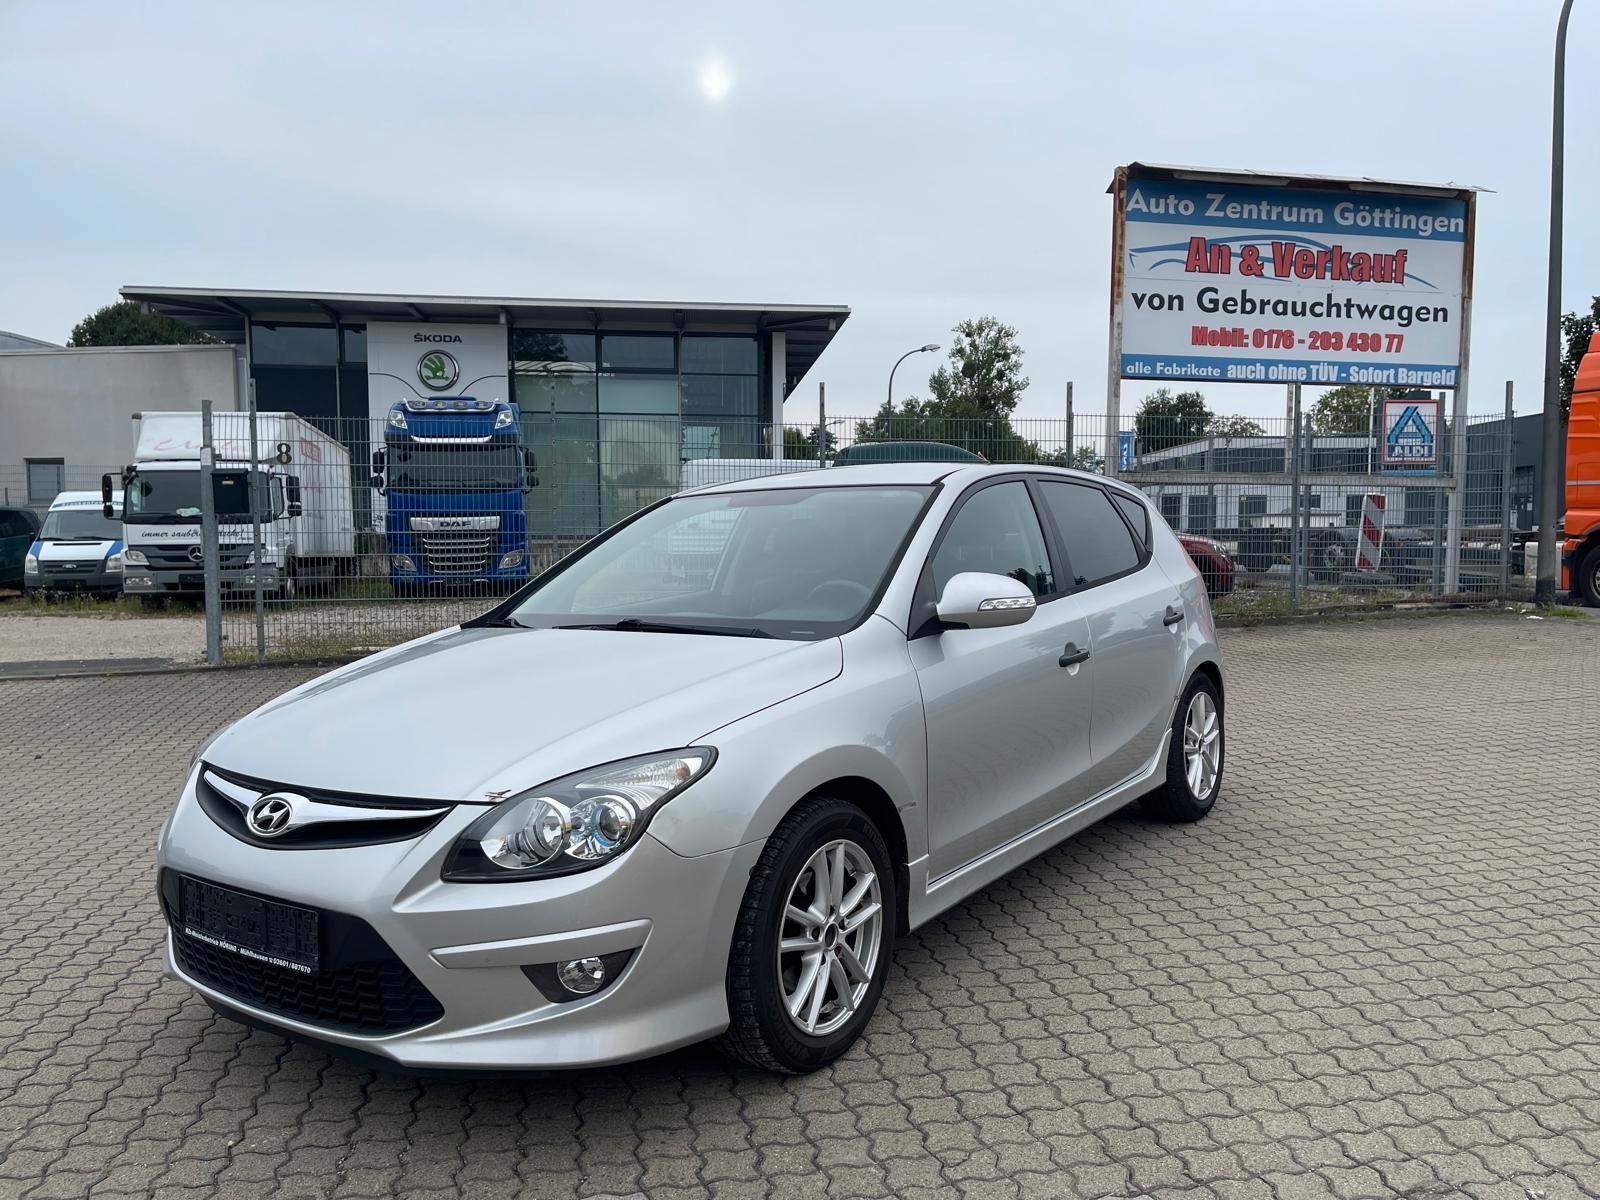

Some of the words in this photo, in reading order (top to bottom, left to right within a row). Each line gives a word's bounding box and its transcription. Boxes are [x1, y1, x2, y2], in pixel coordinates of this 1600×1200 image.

[1125, 188, 1195, 217] Auto
[1205, 193, 1324, 224] Zentrum
[1334, 202, 1464, 236] Göttingen
[1185, 237, 1231, 275] An
[1239, 244, 1264, 278] &
[1271, 241, 1408, 285] Verkauf
[1131, 291, 1185, 312] von
[1196, 287, 1449, 327] Gebrauchtwagen
[413, 332, 463, 343] ŠKODA
[1191, 326, 1249, 348] Mobil:
[1252, 328, 1295, 350] 0176
[1308, 330, 1344, 351] 203
[1346, 332, 1382, 353] 430
[1385, 333, 1404, 353] 77
[1126, 362, 1152, 374] alle
[1156, 362, 1221, 377] Fabrikate
[1227, 363, 1266, 379] auch
[1268, 364, 1306, 381] ohne
[1310, 363, 1340, 382] TÜV
[1350, 366, 1395, 384] Sofort
[1397, 367, 1455, 386] Bargeld
[276, 442, 292, 465] 8
[1391, 445, 1429, 457] ALDI
